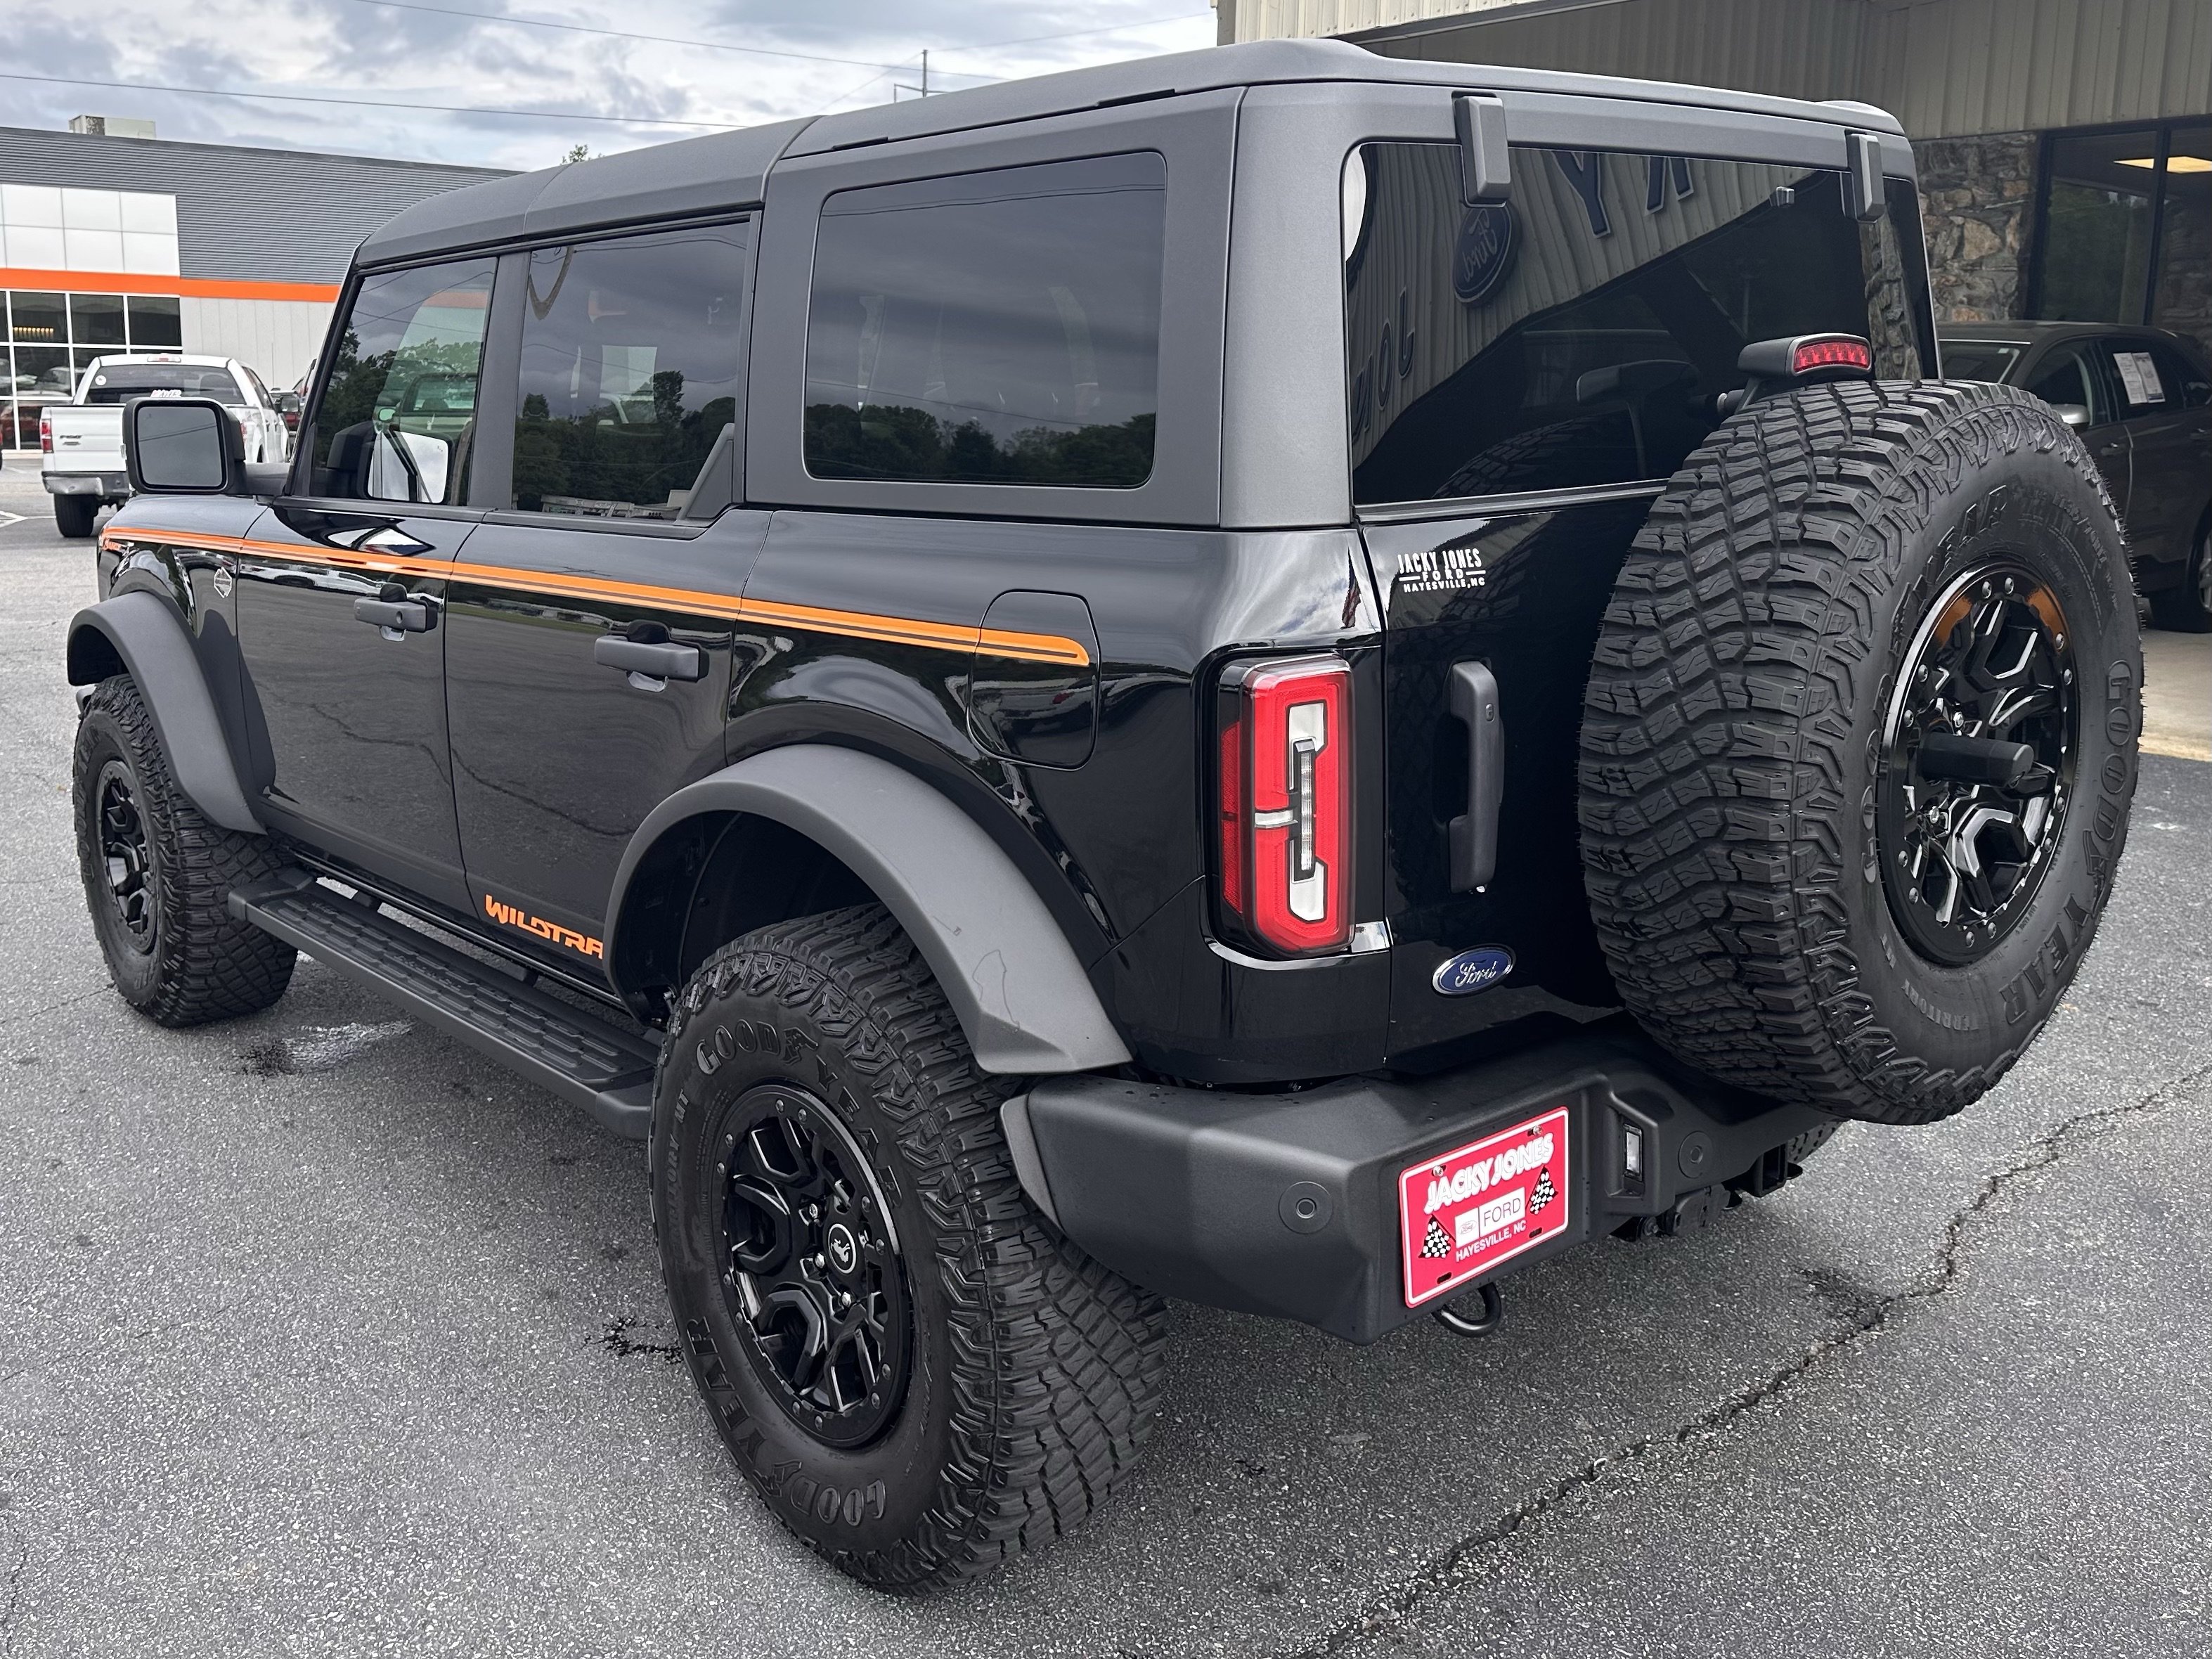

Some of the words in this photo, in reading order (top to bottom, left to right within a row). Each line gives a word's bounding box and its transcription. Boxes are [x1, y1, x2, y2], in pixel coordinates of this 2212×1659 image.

[1397, 551, 1438, 574] JACKY
[1442, 548, 1482, 571] JONES
[1422, 568, 1463, 582] FORD
[485, 893, 604, 960] WILDTRA
[1454, 960, 1498, 988] Ford
[1423, 1157, 1494, 1215] JACKY
[1490, 1132, 1555, 1187] JONES
[1483, 1197, 1521, 1227] FORD
[1455, 1230, 1512, 1263] HAYESVILLE,
[1513, 1220, 1527, 1236] NC
